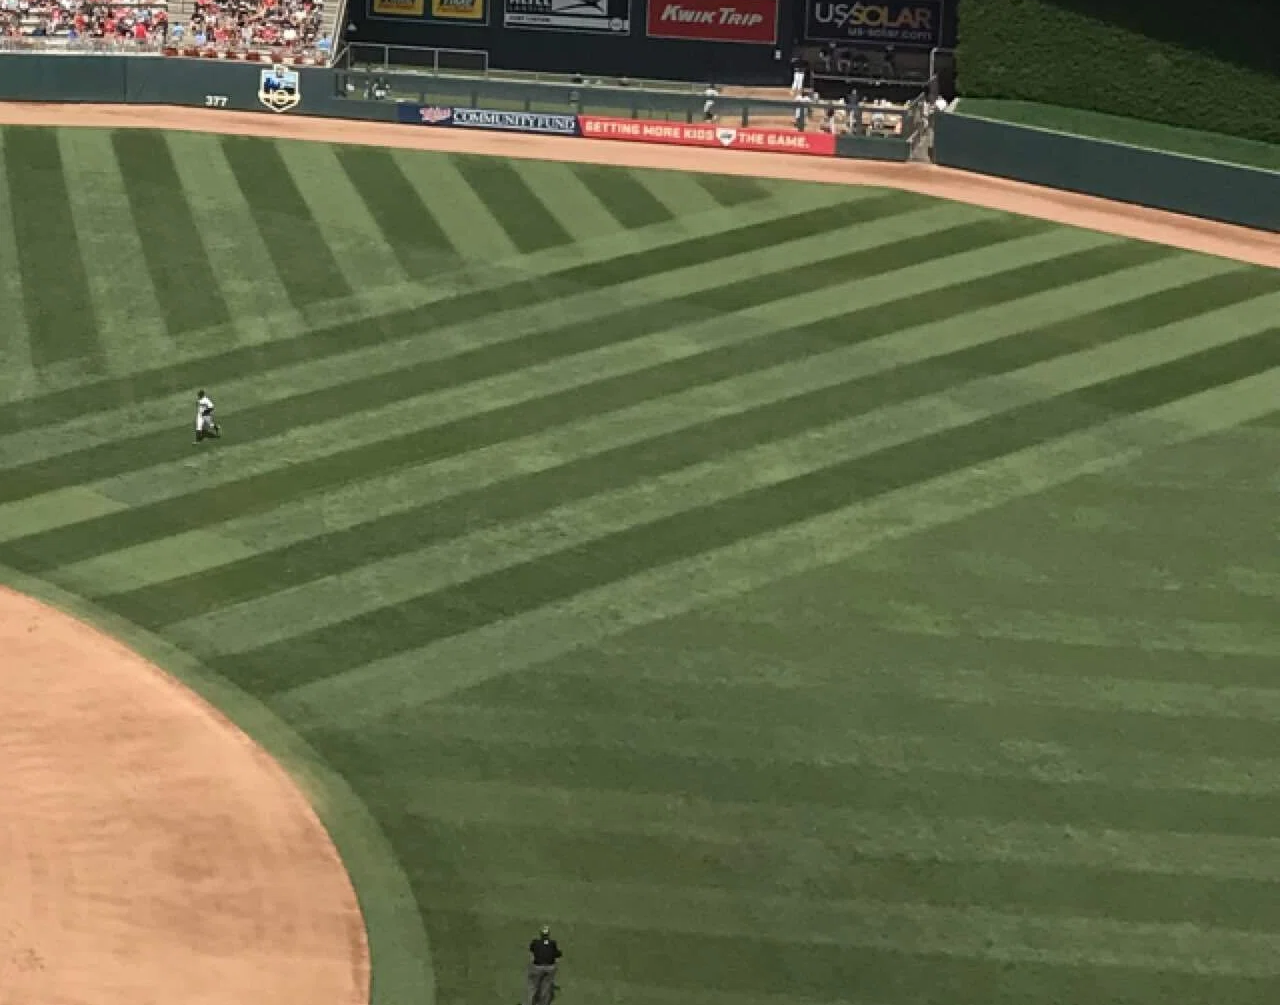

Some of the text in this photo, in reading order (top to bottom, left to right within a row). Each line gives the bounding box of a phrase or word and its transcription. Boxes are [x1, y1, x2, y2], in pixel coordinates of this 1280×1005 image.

[452, 108, 537, 129] COMMUNITY
[538, 114, 576, 133] FUND
[585, 119, 640, 138] GETTING
[643, 124, 681, 140] MORE
[683, 127, 714, 141] KIDS
[738, 132, 764, 145] THE
[767, 133, 811, 148] GAME.
